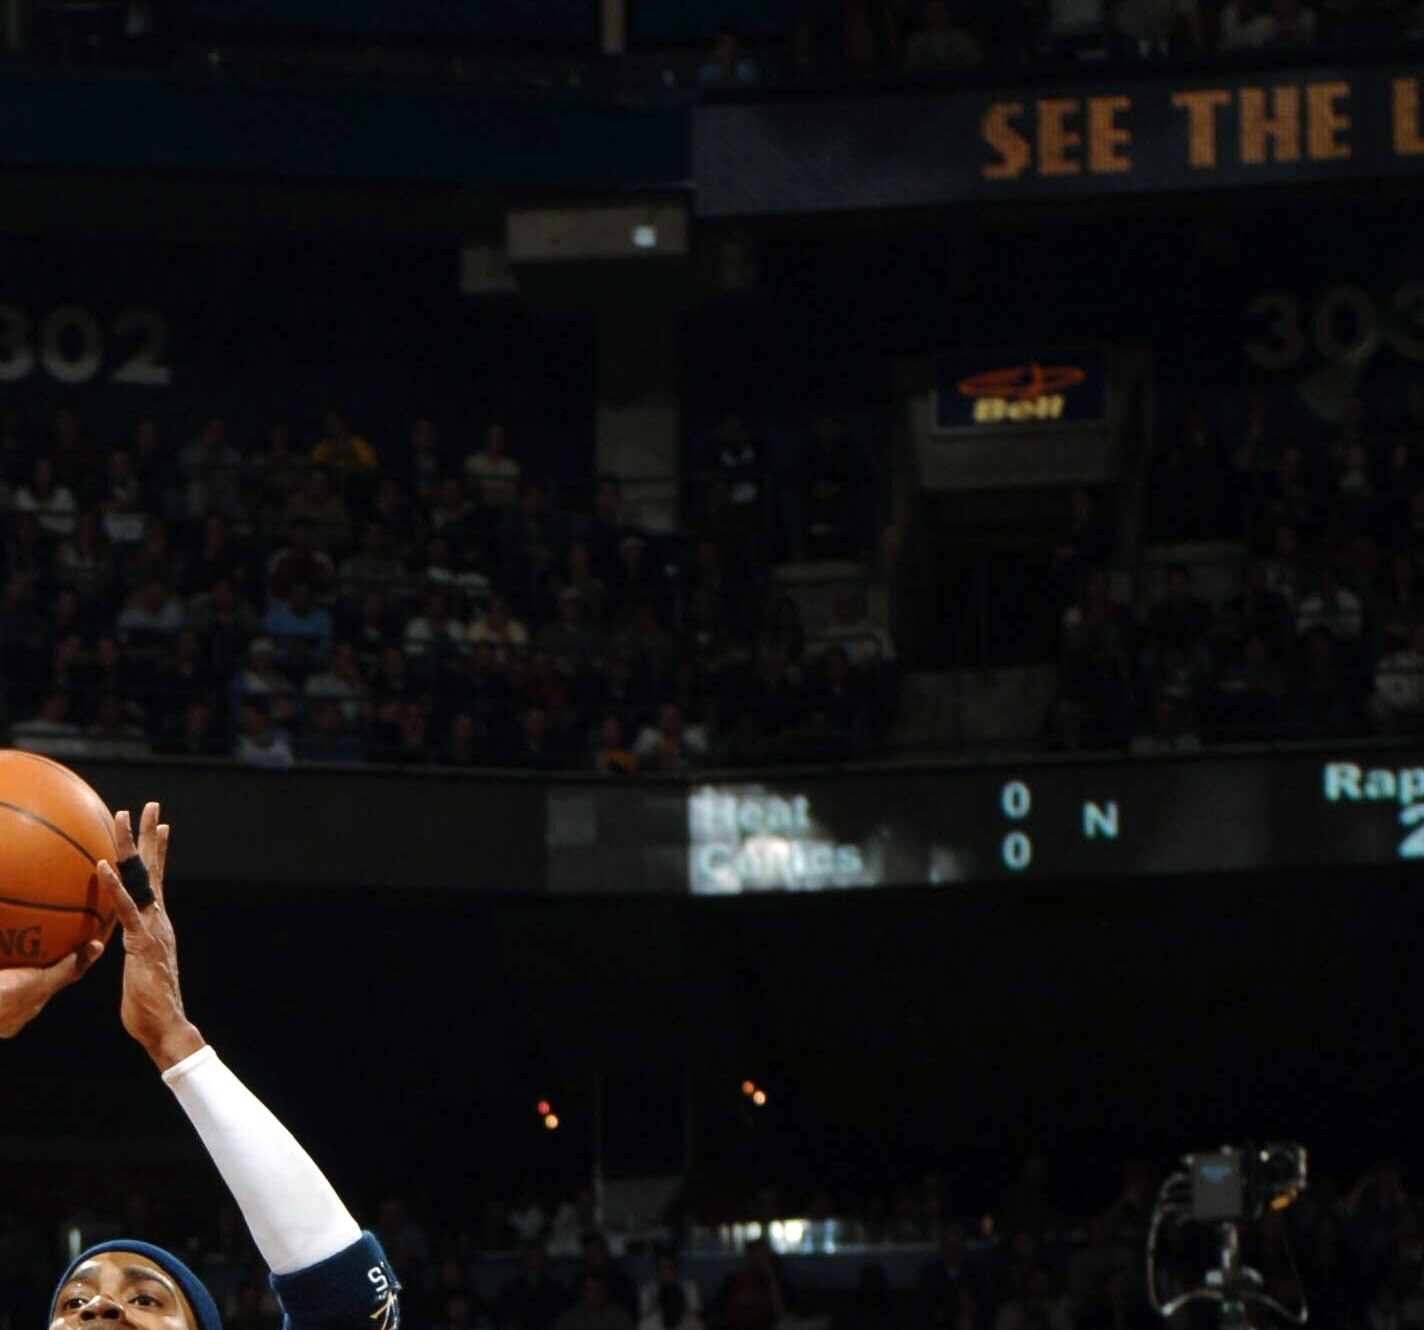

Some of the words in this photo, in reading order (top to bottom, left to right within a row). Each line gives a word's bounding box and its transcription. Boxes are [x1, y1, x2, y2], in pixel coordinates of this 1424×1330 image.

[980, 94, 1133, 180] SEE
[1172, 80, 1352, 167] THE
[1001, 779, 1033, 821] 0
[1083, 802, 1119, 839] N
[1001, 830, 1033, 872] 0
